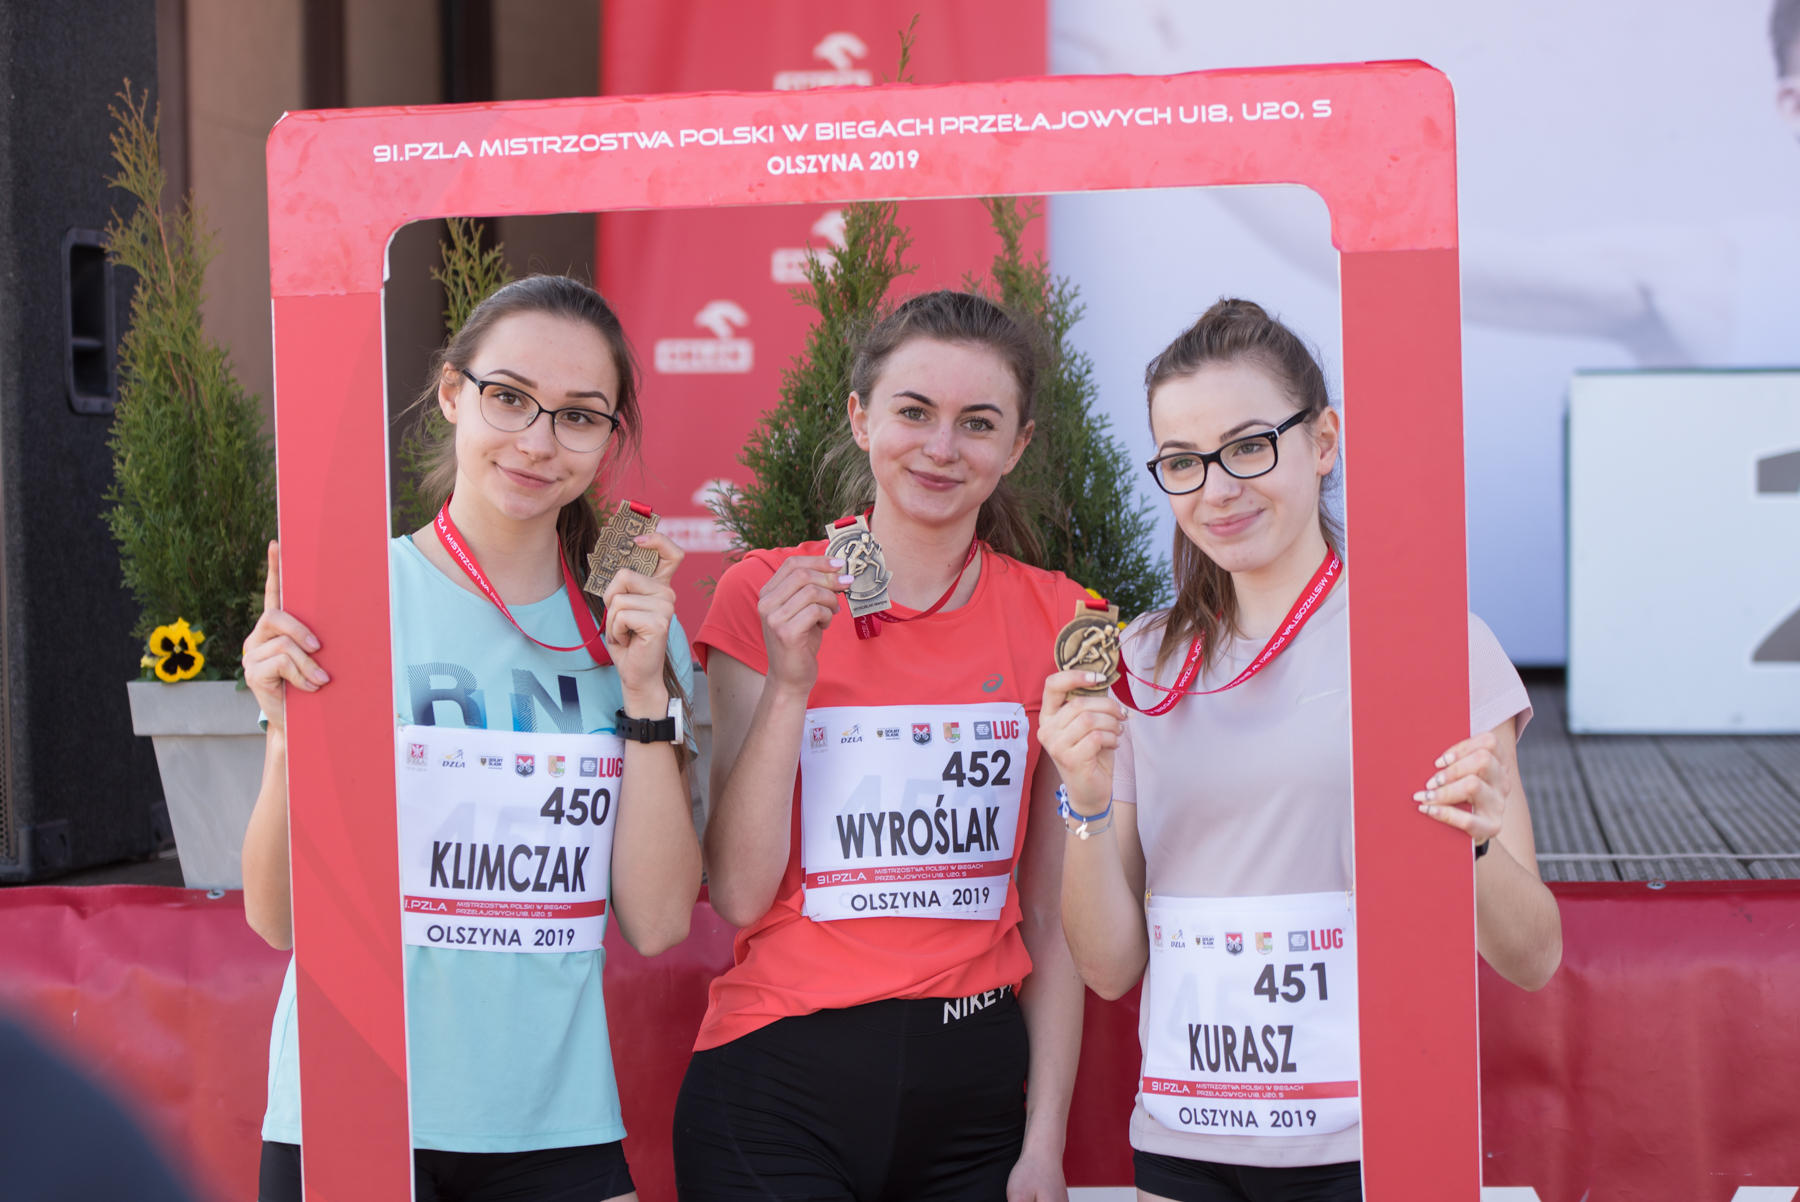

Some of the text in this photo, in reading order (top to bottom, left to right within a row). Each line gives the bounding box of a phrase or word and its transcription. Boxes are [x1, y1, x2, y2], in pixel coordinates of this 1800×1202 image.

[373, 140, 473, 163] 91.PZLA
[479, 131, 674, 157] MISTRZOSTWA
[680, 125, 774, 148] POLSKI
[782, 124, 808, 142] W
[816, 118, 934, 140] BIEGACH
[940, 106, 1172, 135] PRZEŁAJOWYCH
[1312, 99, 1332, 118] S
[767, 150, 920, 176] OLSZYNA 2019
[445, 534, 490, 592] MISTRZOSTWA
[1282, 577, 1328, 636] MISTRZOSTWA
[1260, 636, 1285, 664] POLSKI
[840, 736, 862, 744] DZLA
[992, 720, 1019, 740] LUG
[442, 760, 466, 768] DZLA
[598, 757, 623, 778] LUG
[942, 750, 1010, 788] 452
[540, 786, 610, 826] 450
[836, 794, 1000, 860] WYROŚLAK
[430, 840, 590, 892] KLIMCZAK
[874, 866, 924, 874] MISTRZOSTWA
[405, 899, 448, 912] 1.PZLA
[851, 886, 990, 912] OLSZYNA 2019
[427, 924, 575, 946] OLSZYNA 2019
[1310, 928, 1344, 951] LUG
[1254, 962, 1328, 1003] 451
[943, 990, 996, 1024] NIKE
[1188, 1023, 1297, 1074] KURASZ
[1179, 1106, 1317, 1128] OLSZYNA 2019
